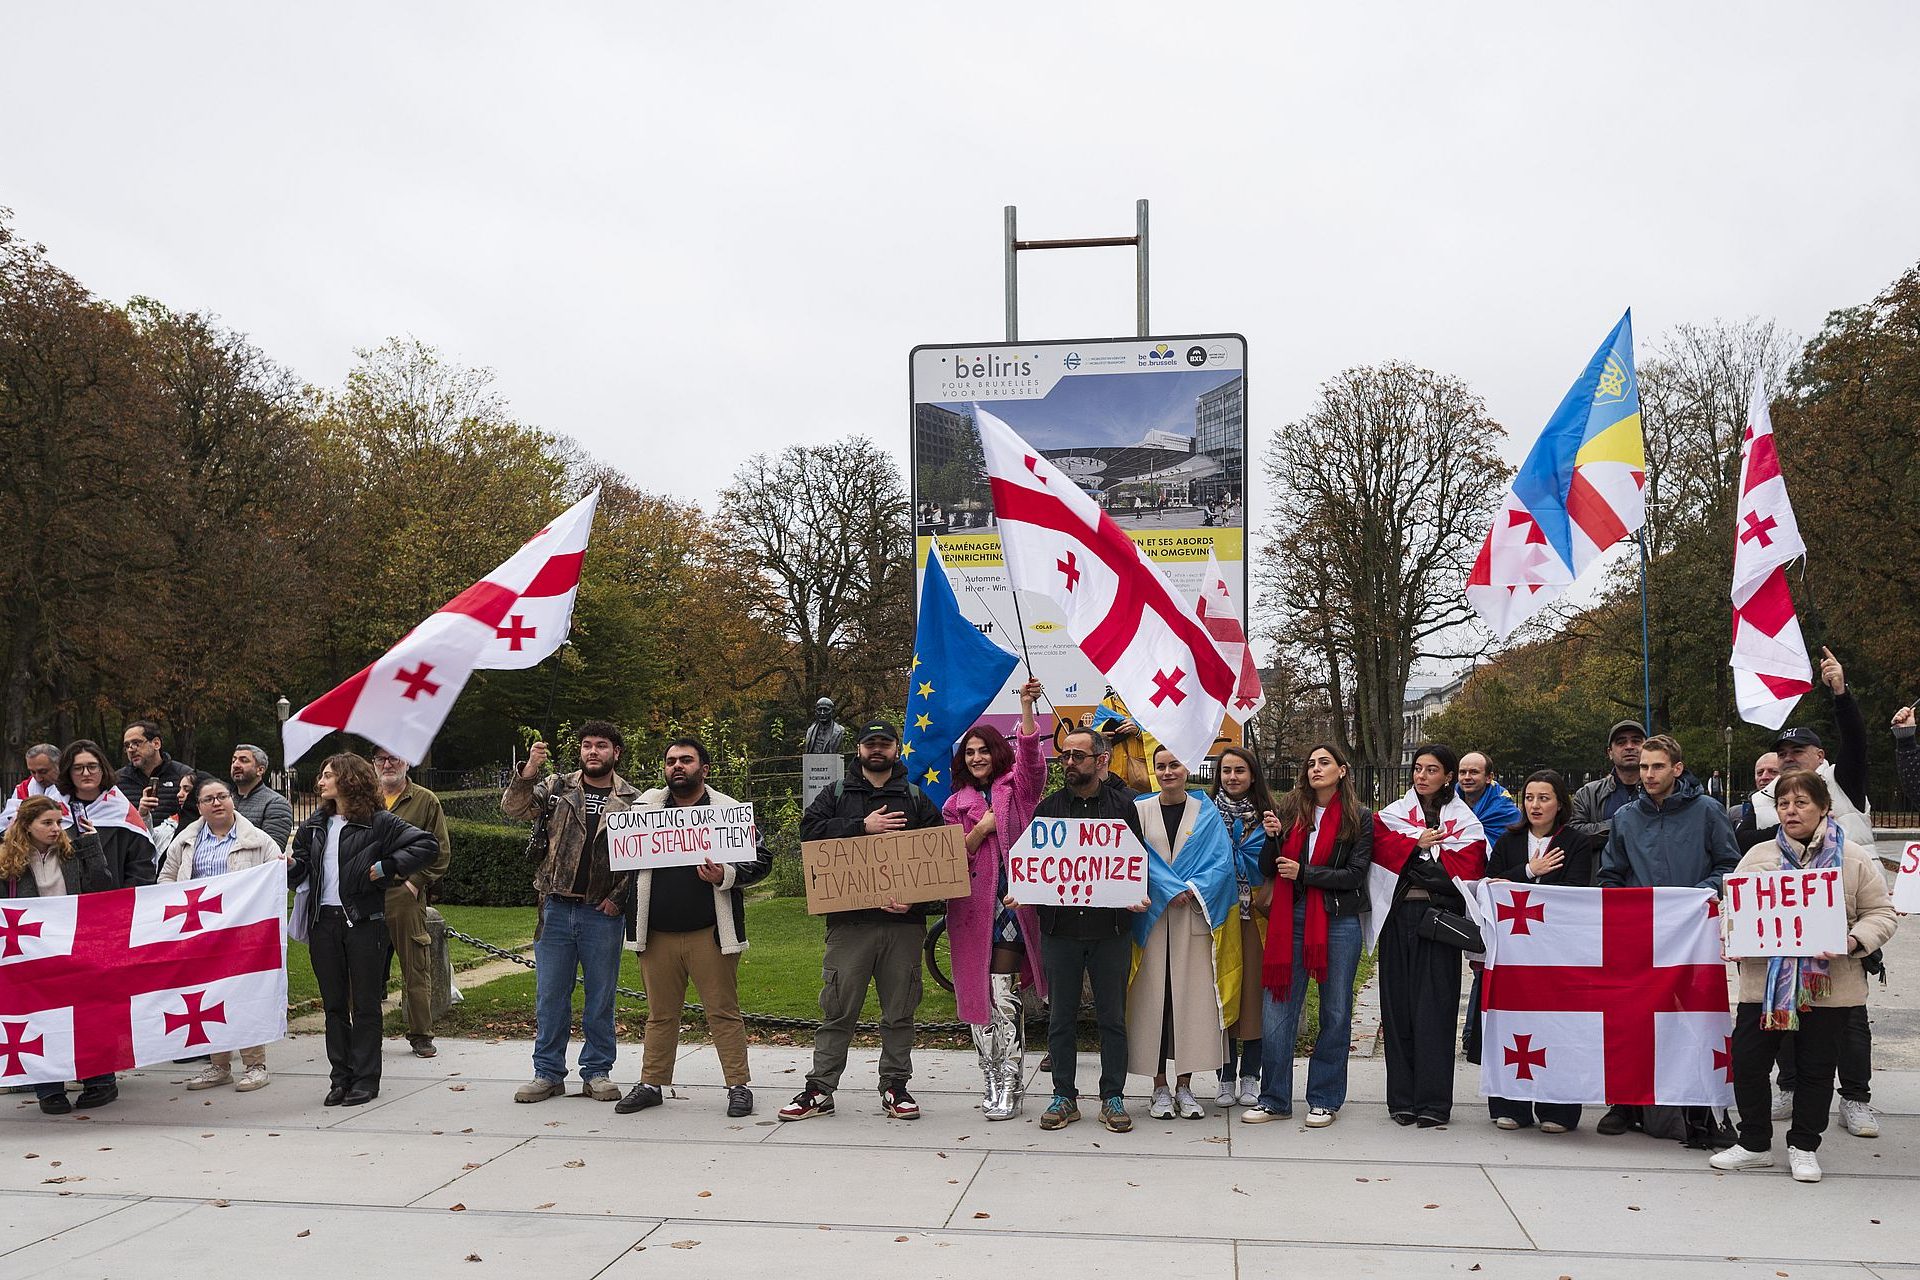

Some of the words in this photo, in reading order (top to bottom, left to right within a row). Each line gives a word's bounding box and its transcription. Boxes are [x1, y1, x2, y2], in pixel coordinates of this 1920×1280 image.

[978, 380, 1039, 388] BRUXELLES
[985, 388, 1039, 396] BRUSSEL
[938, 541, 1001, 552] RÉAMÉNAGEM
[1147, 538, 1156, 546] ET
[1158, 537, 1174, 546] SES
[1176, 537, 1214, 545] ABORDS
[607, 809, 685, 831] COUNTING
[691, 808, 717, 826] OUR
[720, 805, 752, 824] VOTES
[613, 833, 648, 859] NOT
[651, 827, 712, 854] STEALING
[1031, 820, 1067, 849] DO
[1079, 822, 1128, 849] NOT
[1010, 856, 1144, 884] RECOGNIZE
[1901, 844, 1920, 873] S
[818, 857, 964, 901] IVANISHVILI
[1727, 870, 1838, 912] THEFT
[1757, 915, 1803, 949] !!!
